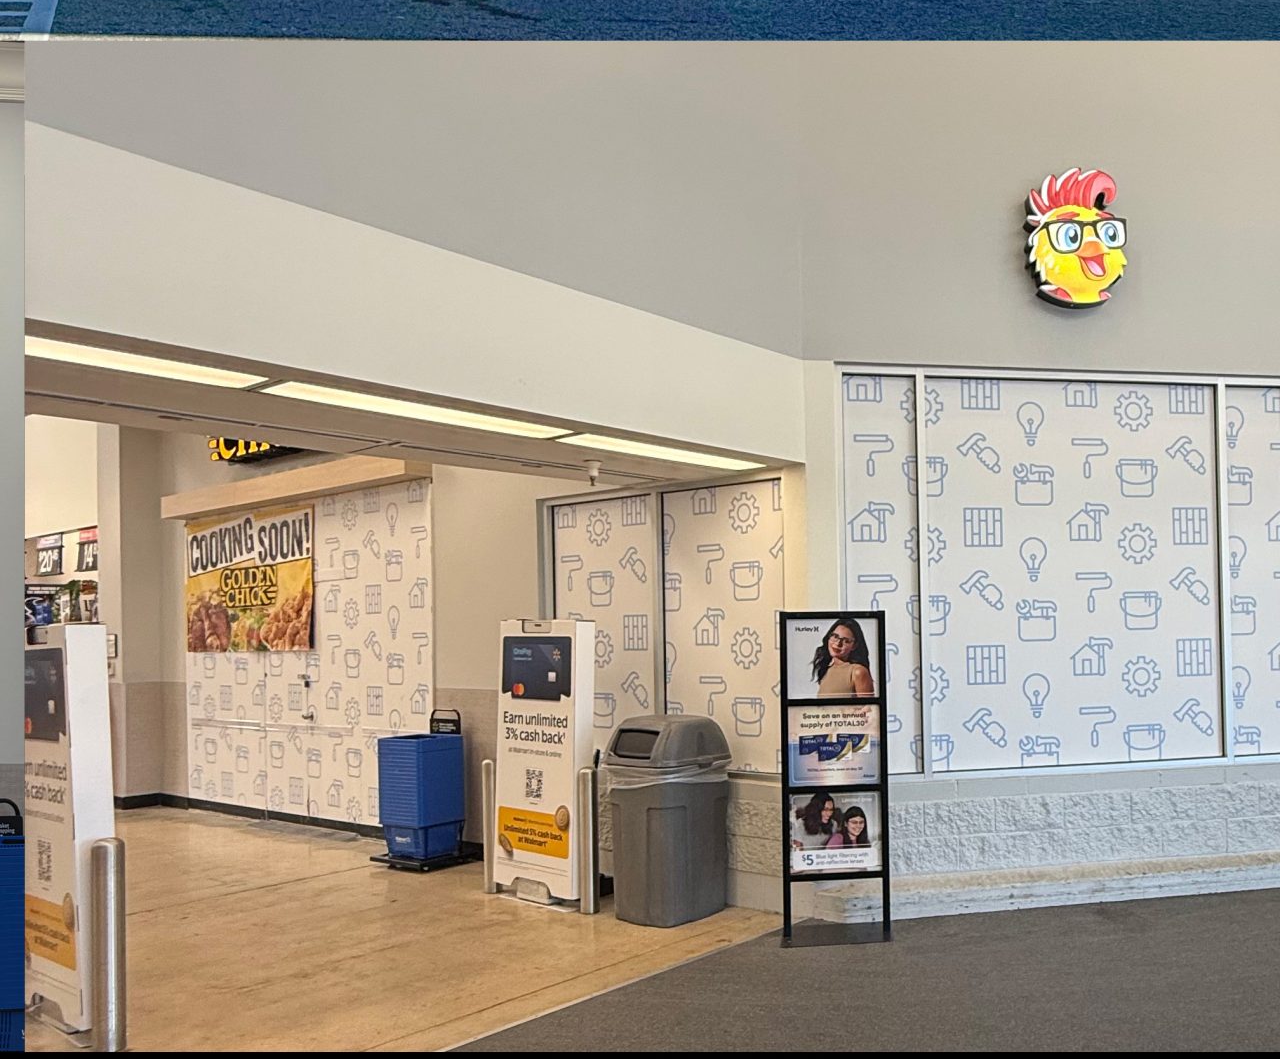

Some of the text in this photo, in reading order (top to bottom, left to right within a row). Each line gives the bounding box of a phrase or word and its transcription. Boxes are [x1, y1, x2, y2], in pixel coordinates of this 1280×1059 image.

[190, 513, 310, 573] COOKING SOON!
[221, 566, 277, 590] GOLDEN
[226, 586, 270, 607] CHICK
[503, 711, 568, 729] Earn unlimited
[505, 727, 518, 740] 3%
[520, 729, 540, 742] cash
[802, 854, 814, 866] $5
